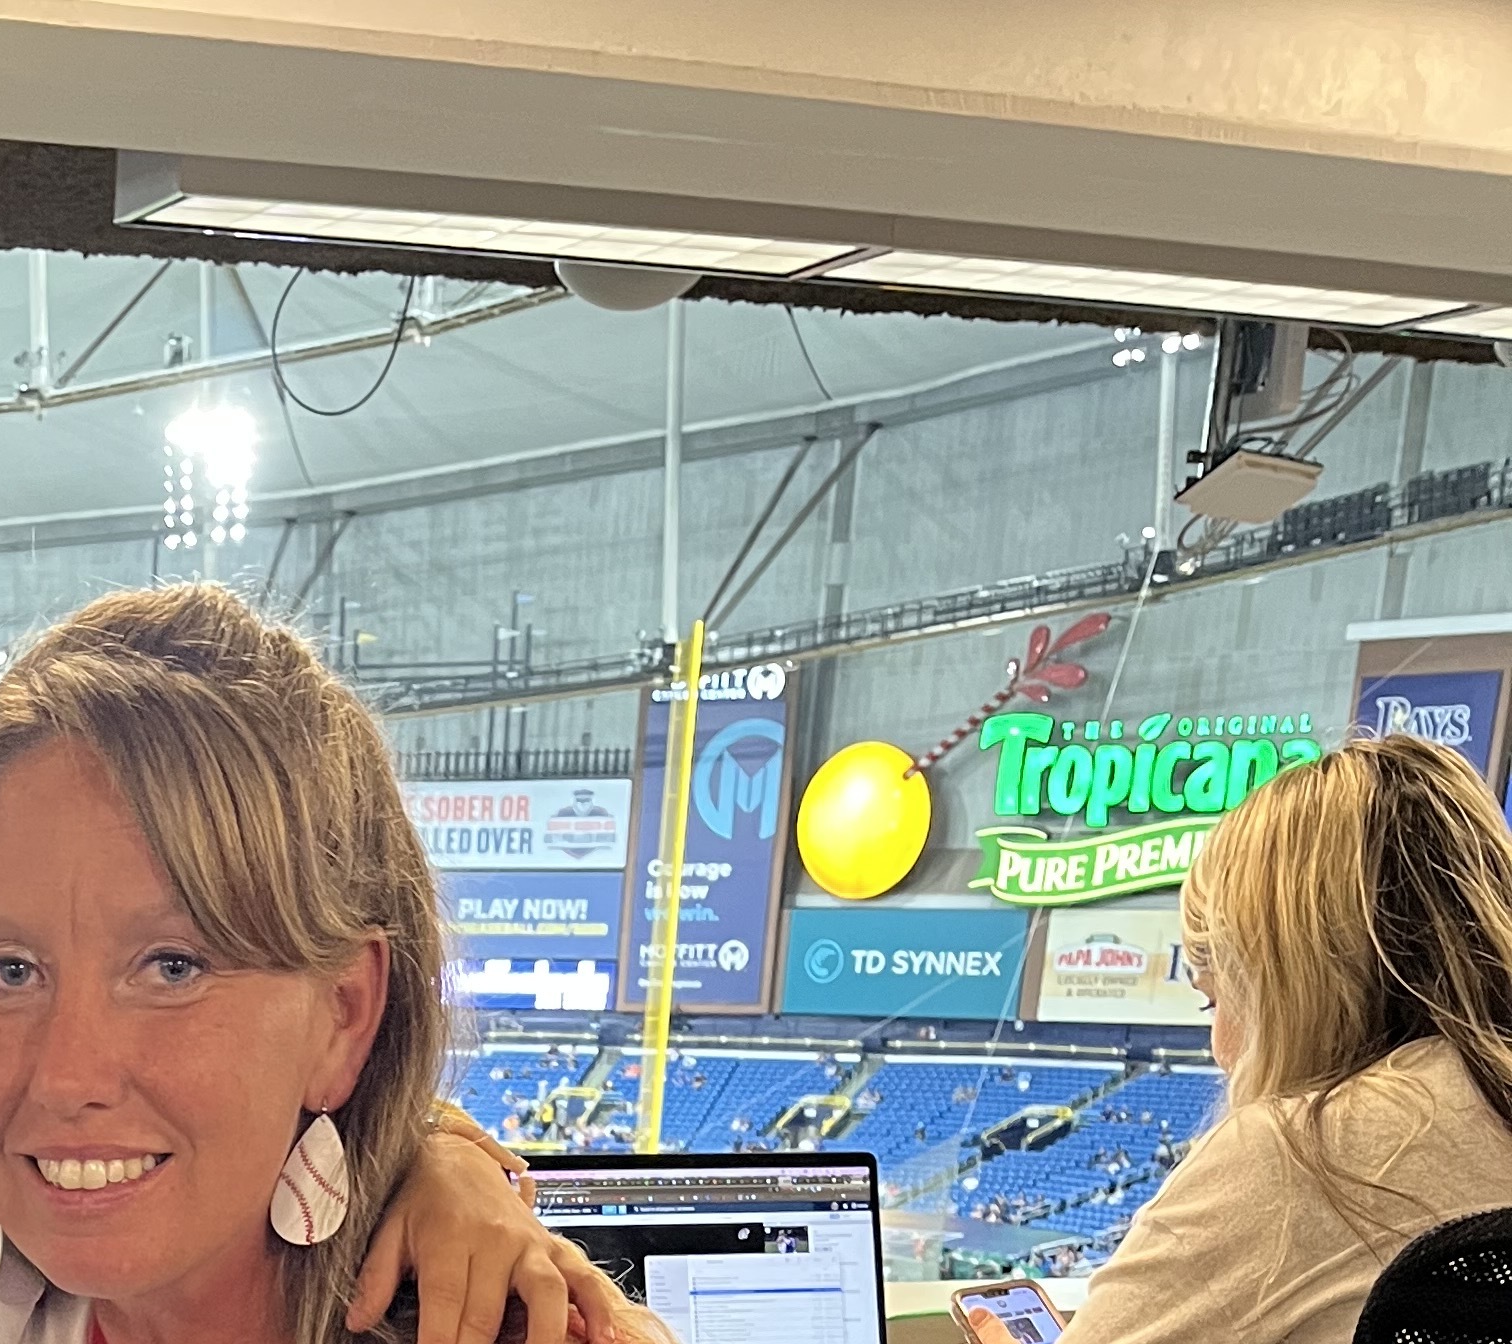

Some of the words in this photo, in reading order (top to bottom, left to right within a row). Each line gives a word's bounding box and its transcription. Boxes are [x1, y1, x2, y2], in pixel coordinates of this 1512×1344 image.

[1061, 720, 1124, 740] THE
[1177, 713, 1313, 738] ORIGINAL
[423, 795, 494, 822] SOBER
[499, 795, 530, 822] OR
[477, 828, 534, 855] OVER
[996, 849, 1088, 893] PURE
[457, 898, 519, 920] PLAY
[522, 898, 589, 920] NOW!
[851, 950, 886, 975] TD
[891, 950, 1003, 977] SYNNEX
